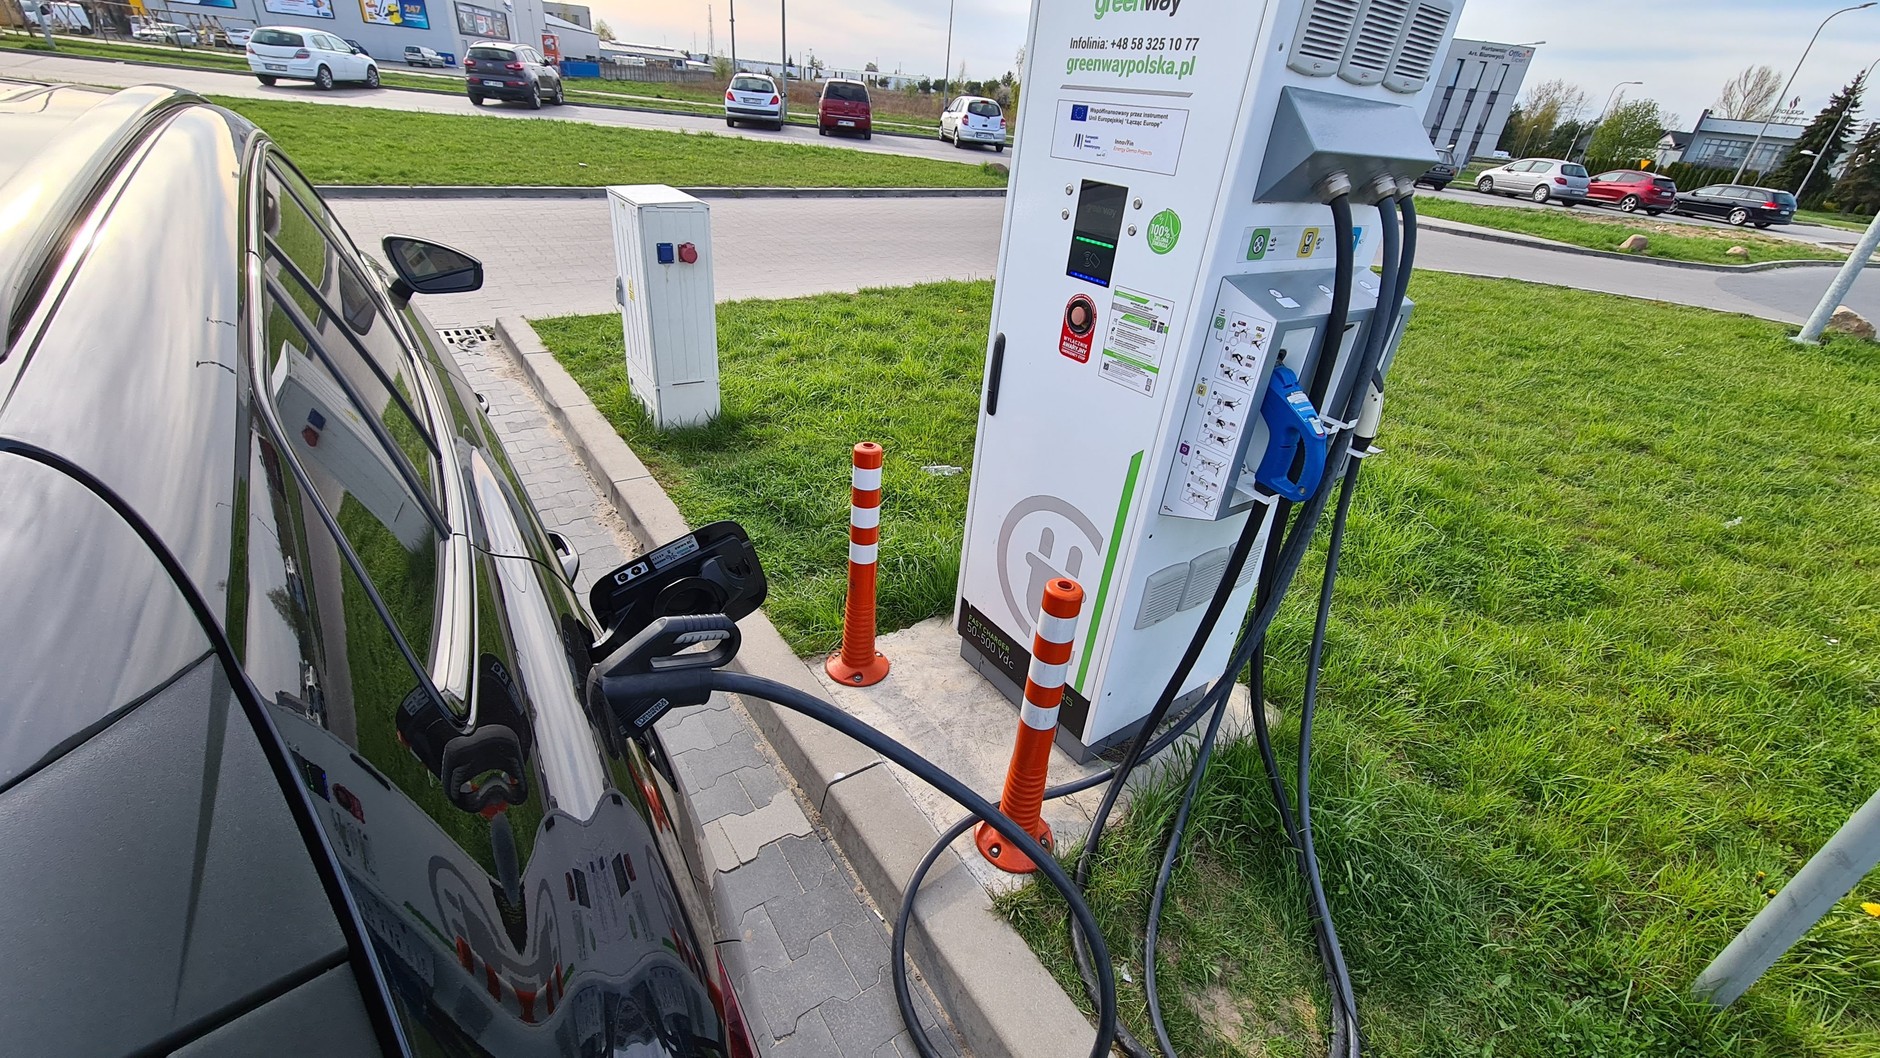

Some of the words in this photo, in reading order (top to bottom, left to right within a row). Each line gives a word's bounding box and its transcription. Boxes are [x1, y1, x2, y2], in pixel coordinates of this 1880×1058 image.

[1069, 36, 1109, 50] Infolinia:
[1110, 37, 1129, 50] +48
[1130, 37, 1144, 50] 58
[1145, 37, 1167, 51] 325
[1169, 37, 1182, 51] 10
[1184, 37, 1200, 51] 77
[1066, 54, 1196, 80] greenwaypolska.pl
[1150, 223, 1171, 240] 100%
[966, 621, 996, 653] 50-500
[998, 646, 1015, 670] Vdc
[968, 614, 982, 629] FAST
[982, 626, 1010, 655] CHARGER
